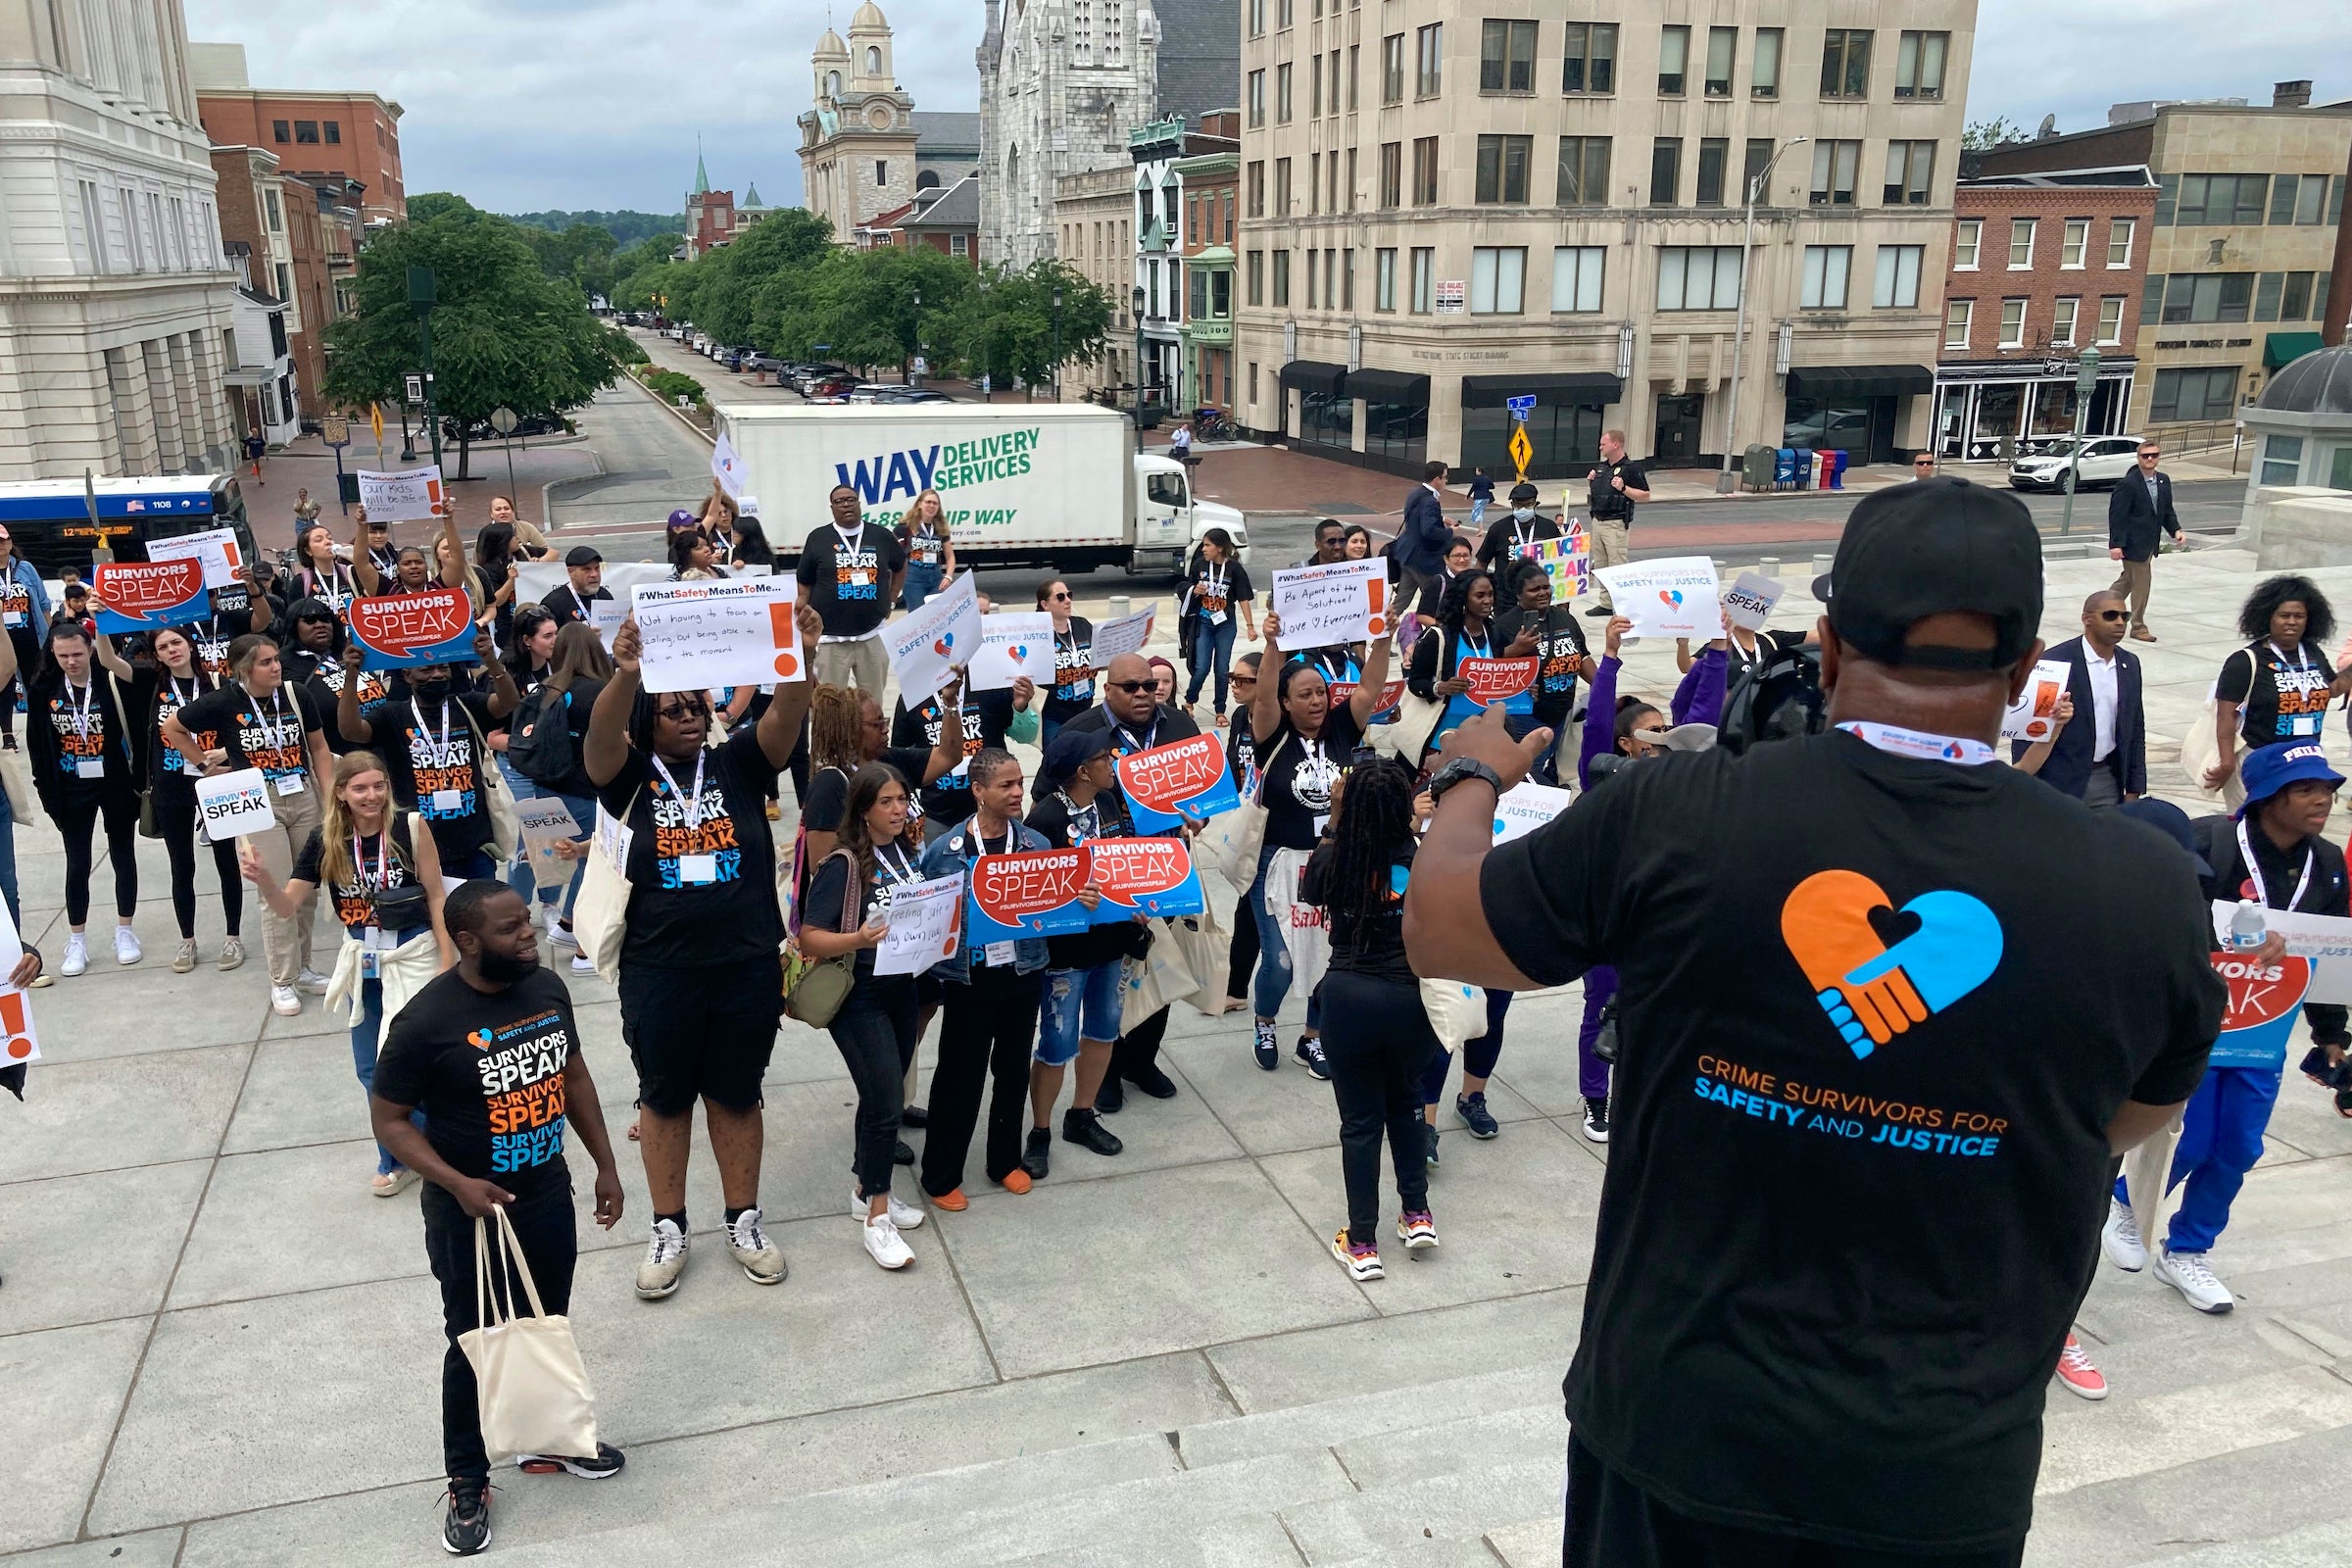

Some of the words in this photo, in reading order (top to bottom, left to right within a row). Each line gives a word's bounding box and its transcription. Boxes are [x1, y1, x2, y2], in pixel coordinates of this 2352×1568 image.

[944, 427, 1041, 466] DELIVERY
[836, 445, 940, 506] WAY
[934, 454, 1031, 492] SERVICES
[975, 510, 1017, 524] WAY
[63, 527, 74, 536] 12
[104, 564, 188, 580] SURVIVORS
[835, 559, 878, 567] SPEAK
[1278, 565, 1376, 582] #WhatSafetyMeansToMe...
[1544, 558, 1588, 579] PEAK
[103, 575, 192, 602] SPEAK
[837, 574, 877, 583] SPK
[1550, 578, 1587, 600] 022
[1616, 579, 1652, 588] SAFETY
[639, 584, 781, 600] #WhatSafetyMeansToMe...
[838, 590, 877, 600] SPEAK
[1285, 592, 1296, 604] Be
[1331, 584, 1340, 593] of
[122, 598, 176, 608] #SURVIVORSSPEAK
[362, 595, 454, 614] SURVIVORS
[1727, 593, 1769, 615] SPEAK
[364, 608, 460, 639] SPEAK
[640, 615, 661, 627] Not
[670, 612, 702, 624] having
[708, 608, 716, 617] to
[726, 607, 747, 616] focus
[895, 629, 919, 648] CRIME
[919, 603, 957, 631] SURVIVORS
[698, 630, 717, 642] being
[899, 631, 930, 658] SAFETY
[947, 598, 972, 625] JUSTICE
[1469, 662, 1530, 671] SURVIVORS
[1466, 670, 1527, 689] SPEAK
[924, 714, 981, 733] SURORS
[1129, 741, 1208, 772] SURVIVORS
[936, 775, 970, 790] SPEA
[1133, 754, 1217, 796] SPEAK
[1154, 782, 1204, 801] #SURVIVORSSPEAK
[206, 797, 267, 819] SPEAK
[654, 798, 729, 828] SPAK
[1505, 807, 1553, 821] JUSTICE
[523, 815, 571, 829] SPEAK
[1094, 843, 1174, 858] SURVIVORS
[987, 854, 1078, 875] SURVIVORS
[1093, 856, 1182, 883] SPEAK
[985, 868, 1077, 904] SPEAK
[1111, 880, 1166, 890] #SURVIVORSSPEAK
[1000, 899, 1057, 910] #SURVIVORSSPEAK
[498, 1028, 523, 1041] SAFETY
[523, 1023, 536, 1033] AND
[536, 1015, 561, 1028] JUSTICE
[514, 1013, 546, 1030] SURVIVORS
[477, 1029, 567, 1074] SURVIVORS
[482, 1043, 568, 1095] SPEAK
[487, 1074, 564, 1108] SURVIVOR
[1697, 1054, 1777, 1095] CRIME
[1784, 1082, 1943, 1127] SURVIVORS
[1951, 1111, 2008, 1134] FOR
[489, 1091, 564, 1134] SPEA
[1694, 1077, 1804, 1127] SAFETY
[1807, 1114, 1864, 1138] AND
[1871, 1124, 1999, 1156] JUSTICE
[492, 1114, 565, 1150] SURVIVO
[492, 1131, 564, 1173] SPEA
